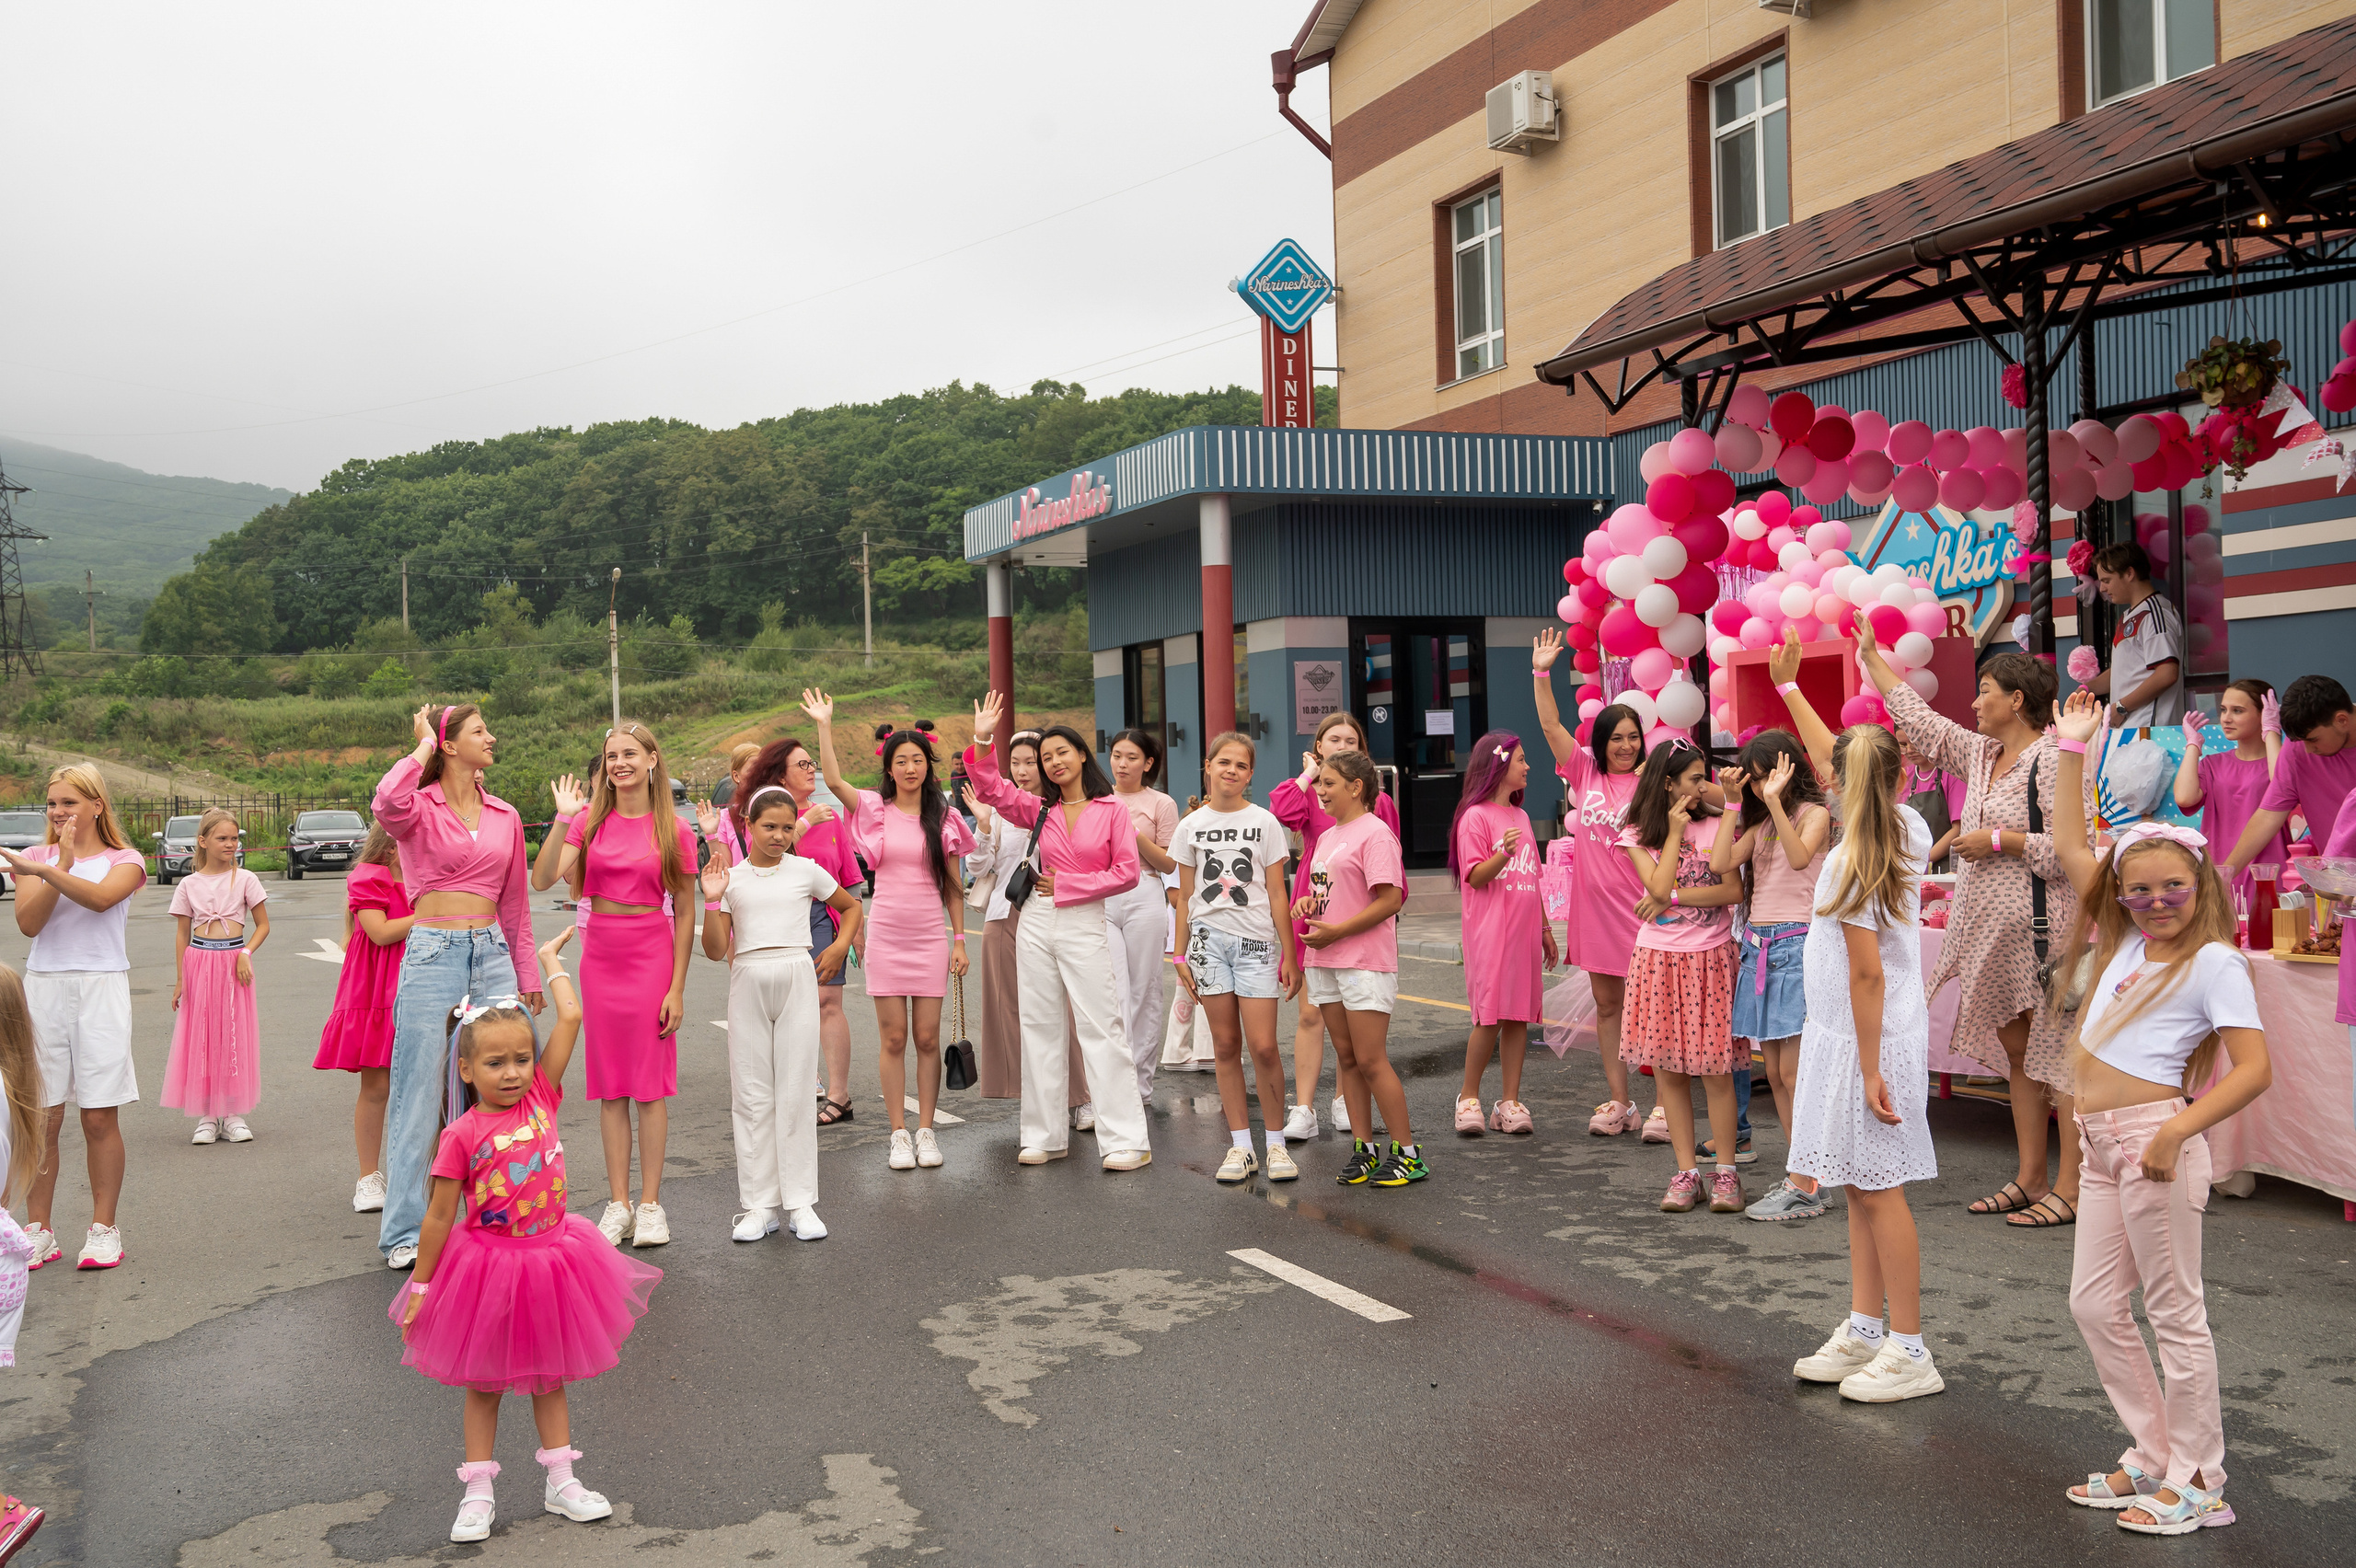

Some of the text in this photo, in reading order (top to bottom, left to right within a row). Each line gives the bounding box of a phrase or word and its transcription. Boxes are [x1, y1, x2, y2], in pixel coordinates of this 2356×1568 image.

[1248, 273, 1330, 294] Narineshka's
[1905, 525, 2021, 590] eshka's
[1302, 706, 1338, 714] 10.00-23.00
[1195, 828, 1262, 842] FOR U!
[1241, 942, 1268, 953] MOUSE
